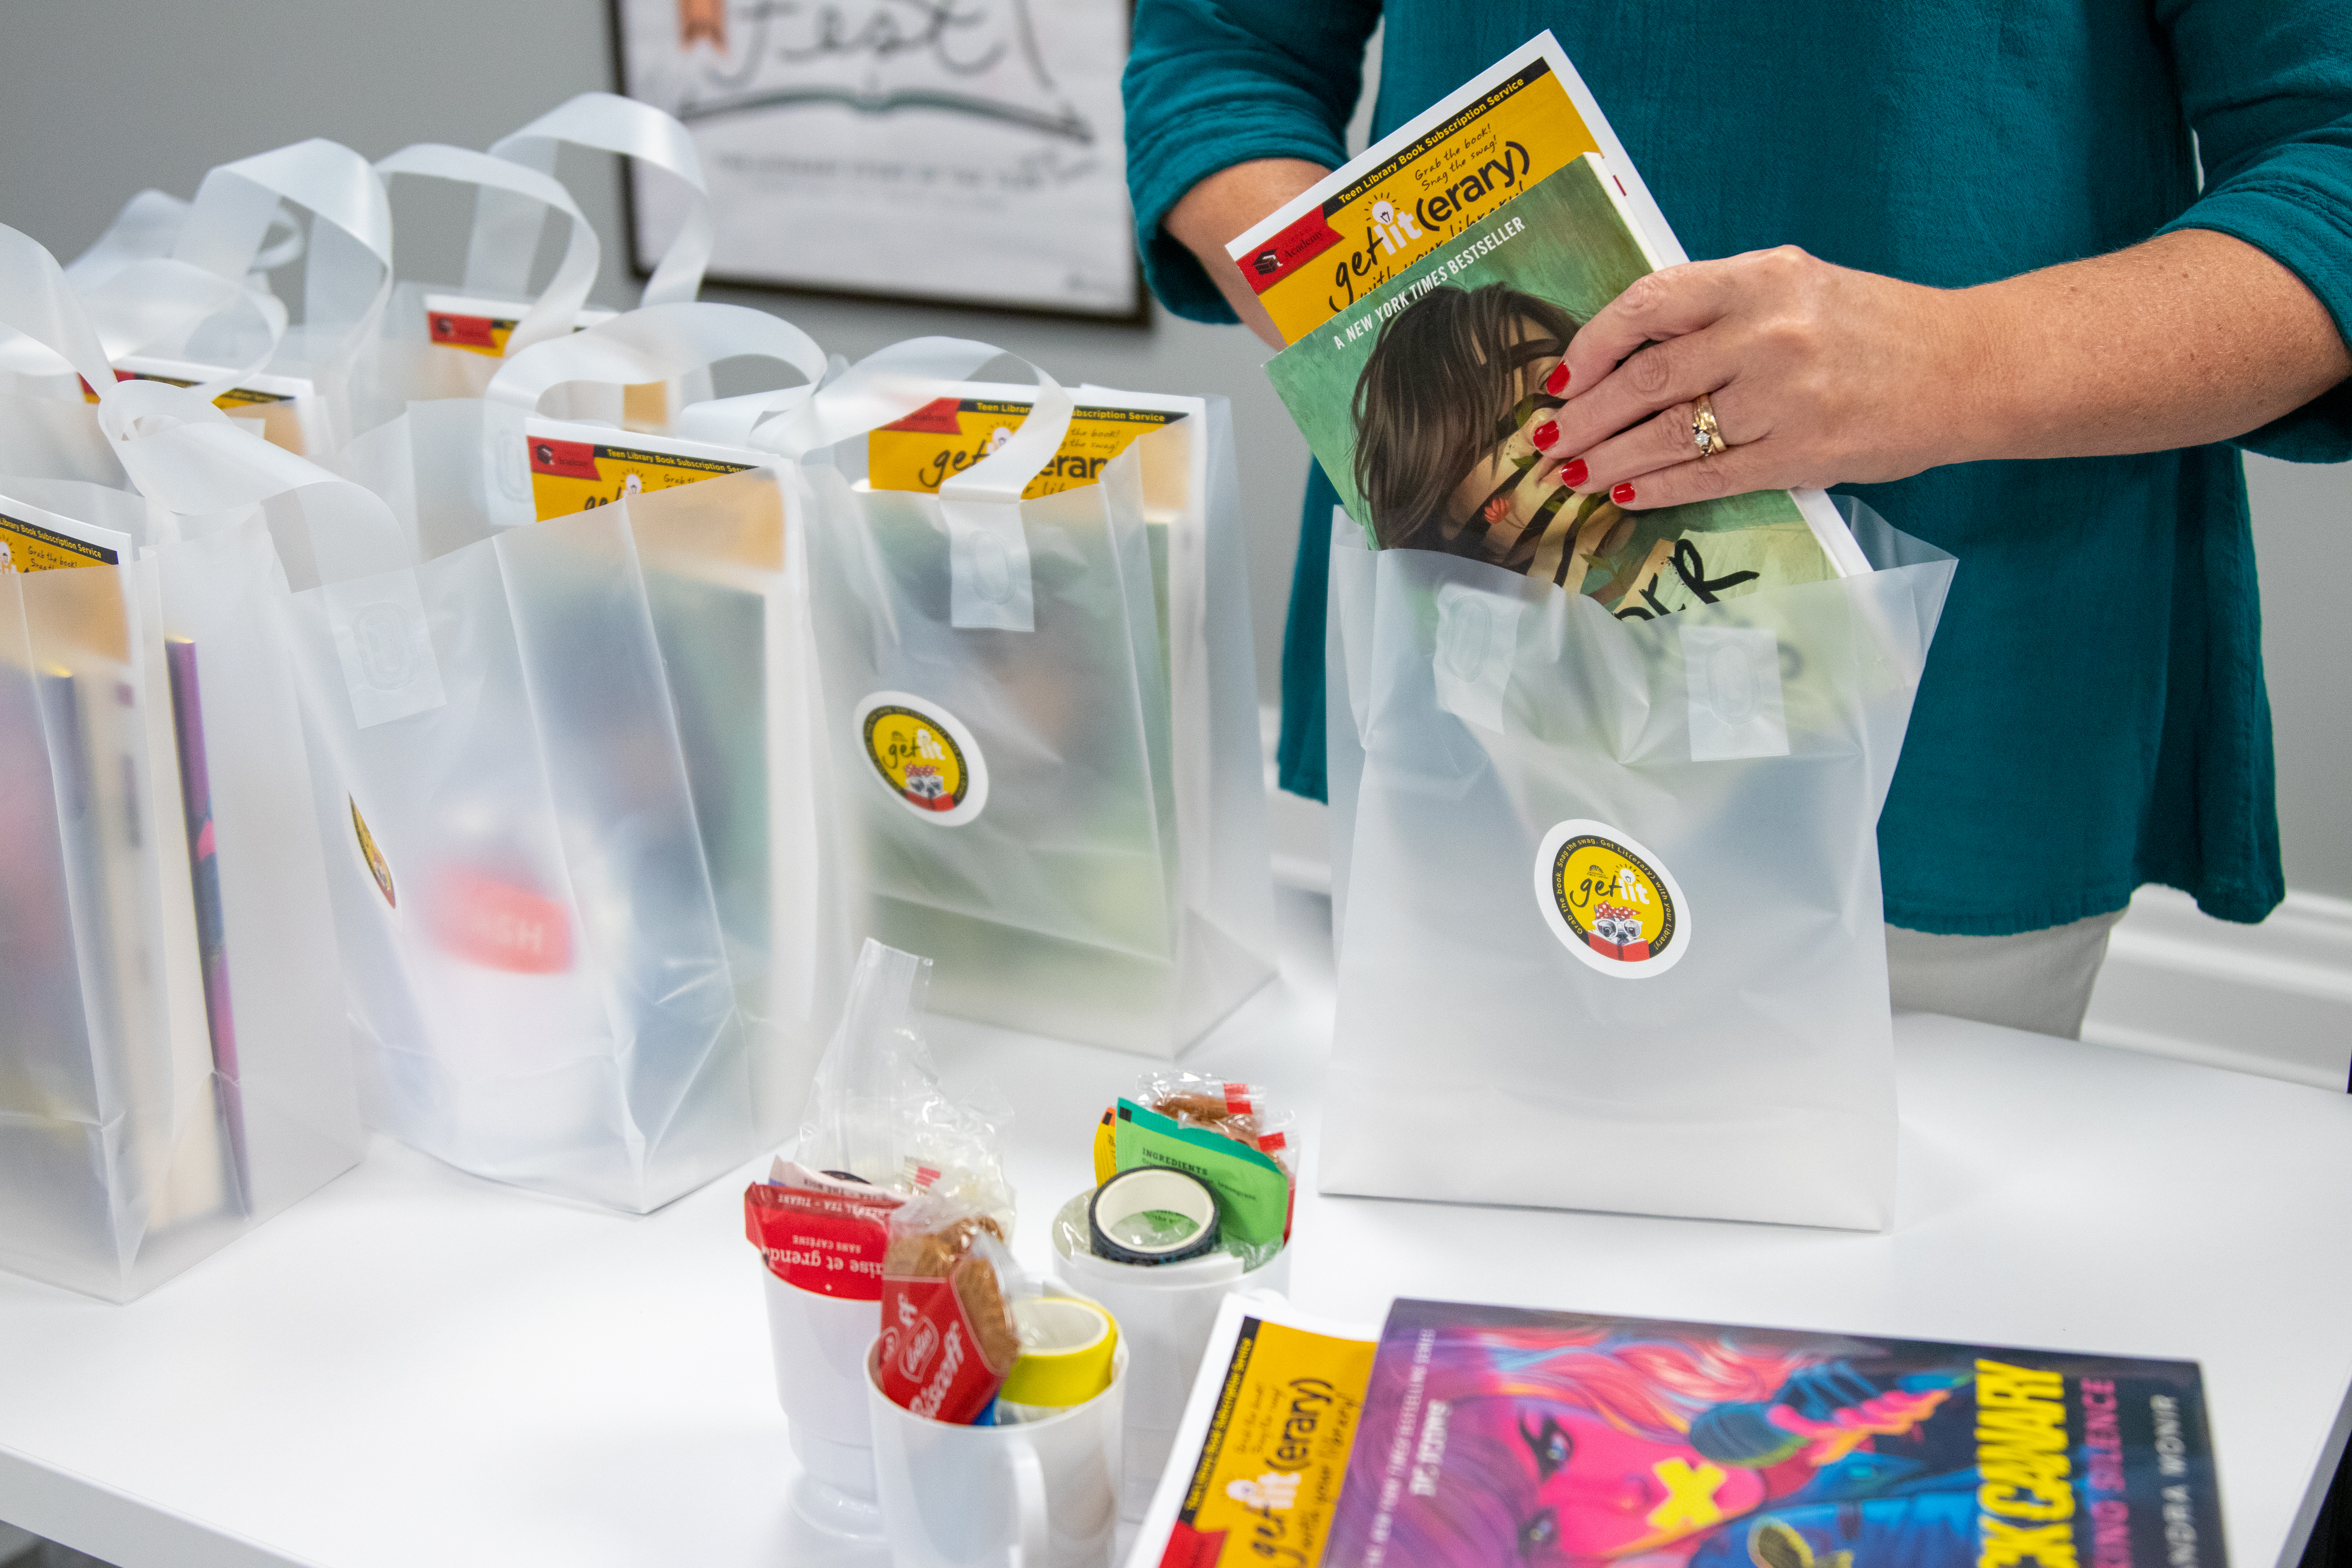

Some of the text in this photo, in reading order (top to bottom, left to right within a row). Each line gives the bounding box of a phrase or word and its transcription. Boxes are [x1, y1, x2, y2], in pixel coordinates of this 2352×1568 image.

[1339, 78, 1524, 203] Teen Library Book Subscription Service
[1415, 123, 1492, 181] Grab the book!
[1422, 134, 1498, 191] Snag the swag!
[1329, 226, 1383, 313] get
[1333, 216, 1526, 350] A NEW YORK TIMES BESTSELLER
[977, 402, 998, 411] Teen
[1002, 405, 1031, 413] Librar
[1129, 412, 1165, 421] Service
[607, 449, 626, 458] Teen
[627, 452, 653, 463] Library
[655, 455, 675, 465] Book
[677, 458, 726, 471] Subscription
[919, 439, 991, 488] get
[20, 524, 37, 536] Book
[37, 530, 77, 550] Subscription
[78, 543, 102, 558] Service
[883, 737, 921, 769] get
[1558, 850, 1568, 867] Snag
[1566, 842, 1577, 851] the
[1601, 839, 1614, 849] Get
[1570, 867, 1650, 908] get lit
[1656, 882, 1668, 901] with
[1568, 914, 1583, 935] Grab
[1663, 902, 1672, 922] your
[1654, 923, 1672, 951] Library!
[1142, 1147, 1209, 1176] INGREDIENTS
[826, 1256, 844, 1271] et
[1974, 1358, 2075, 1521] CANARY
[2080, 1378, 2126, 1491] SILENCE
